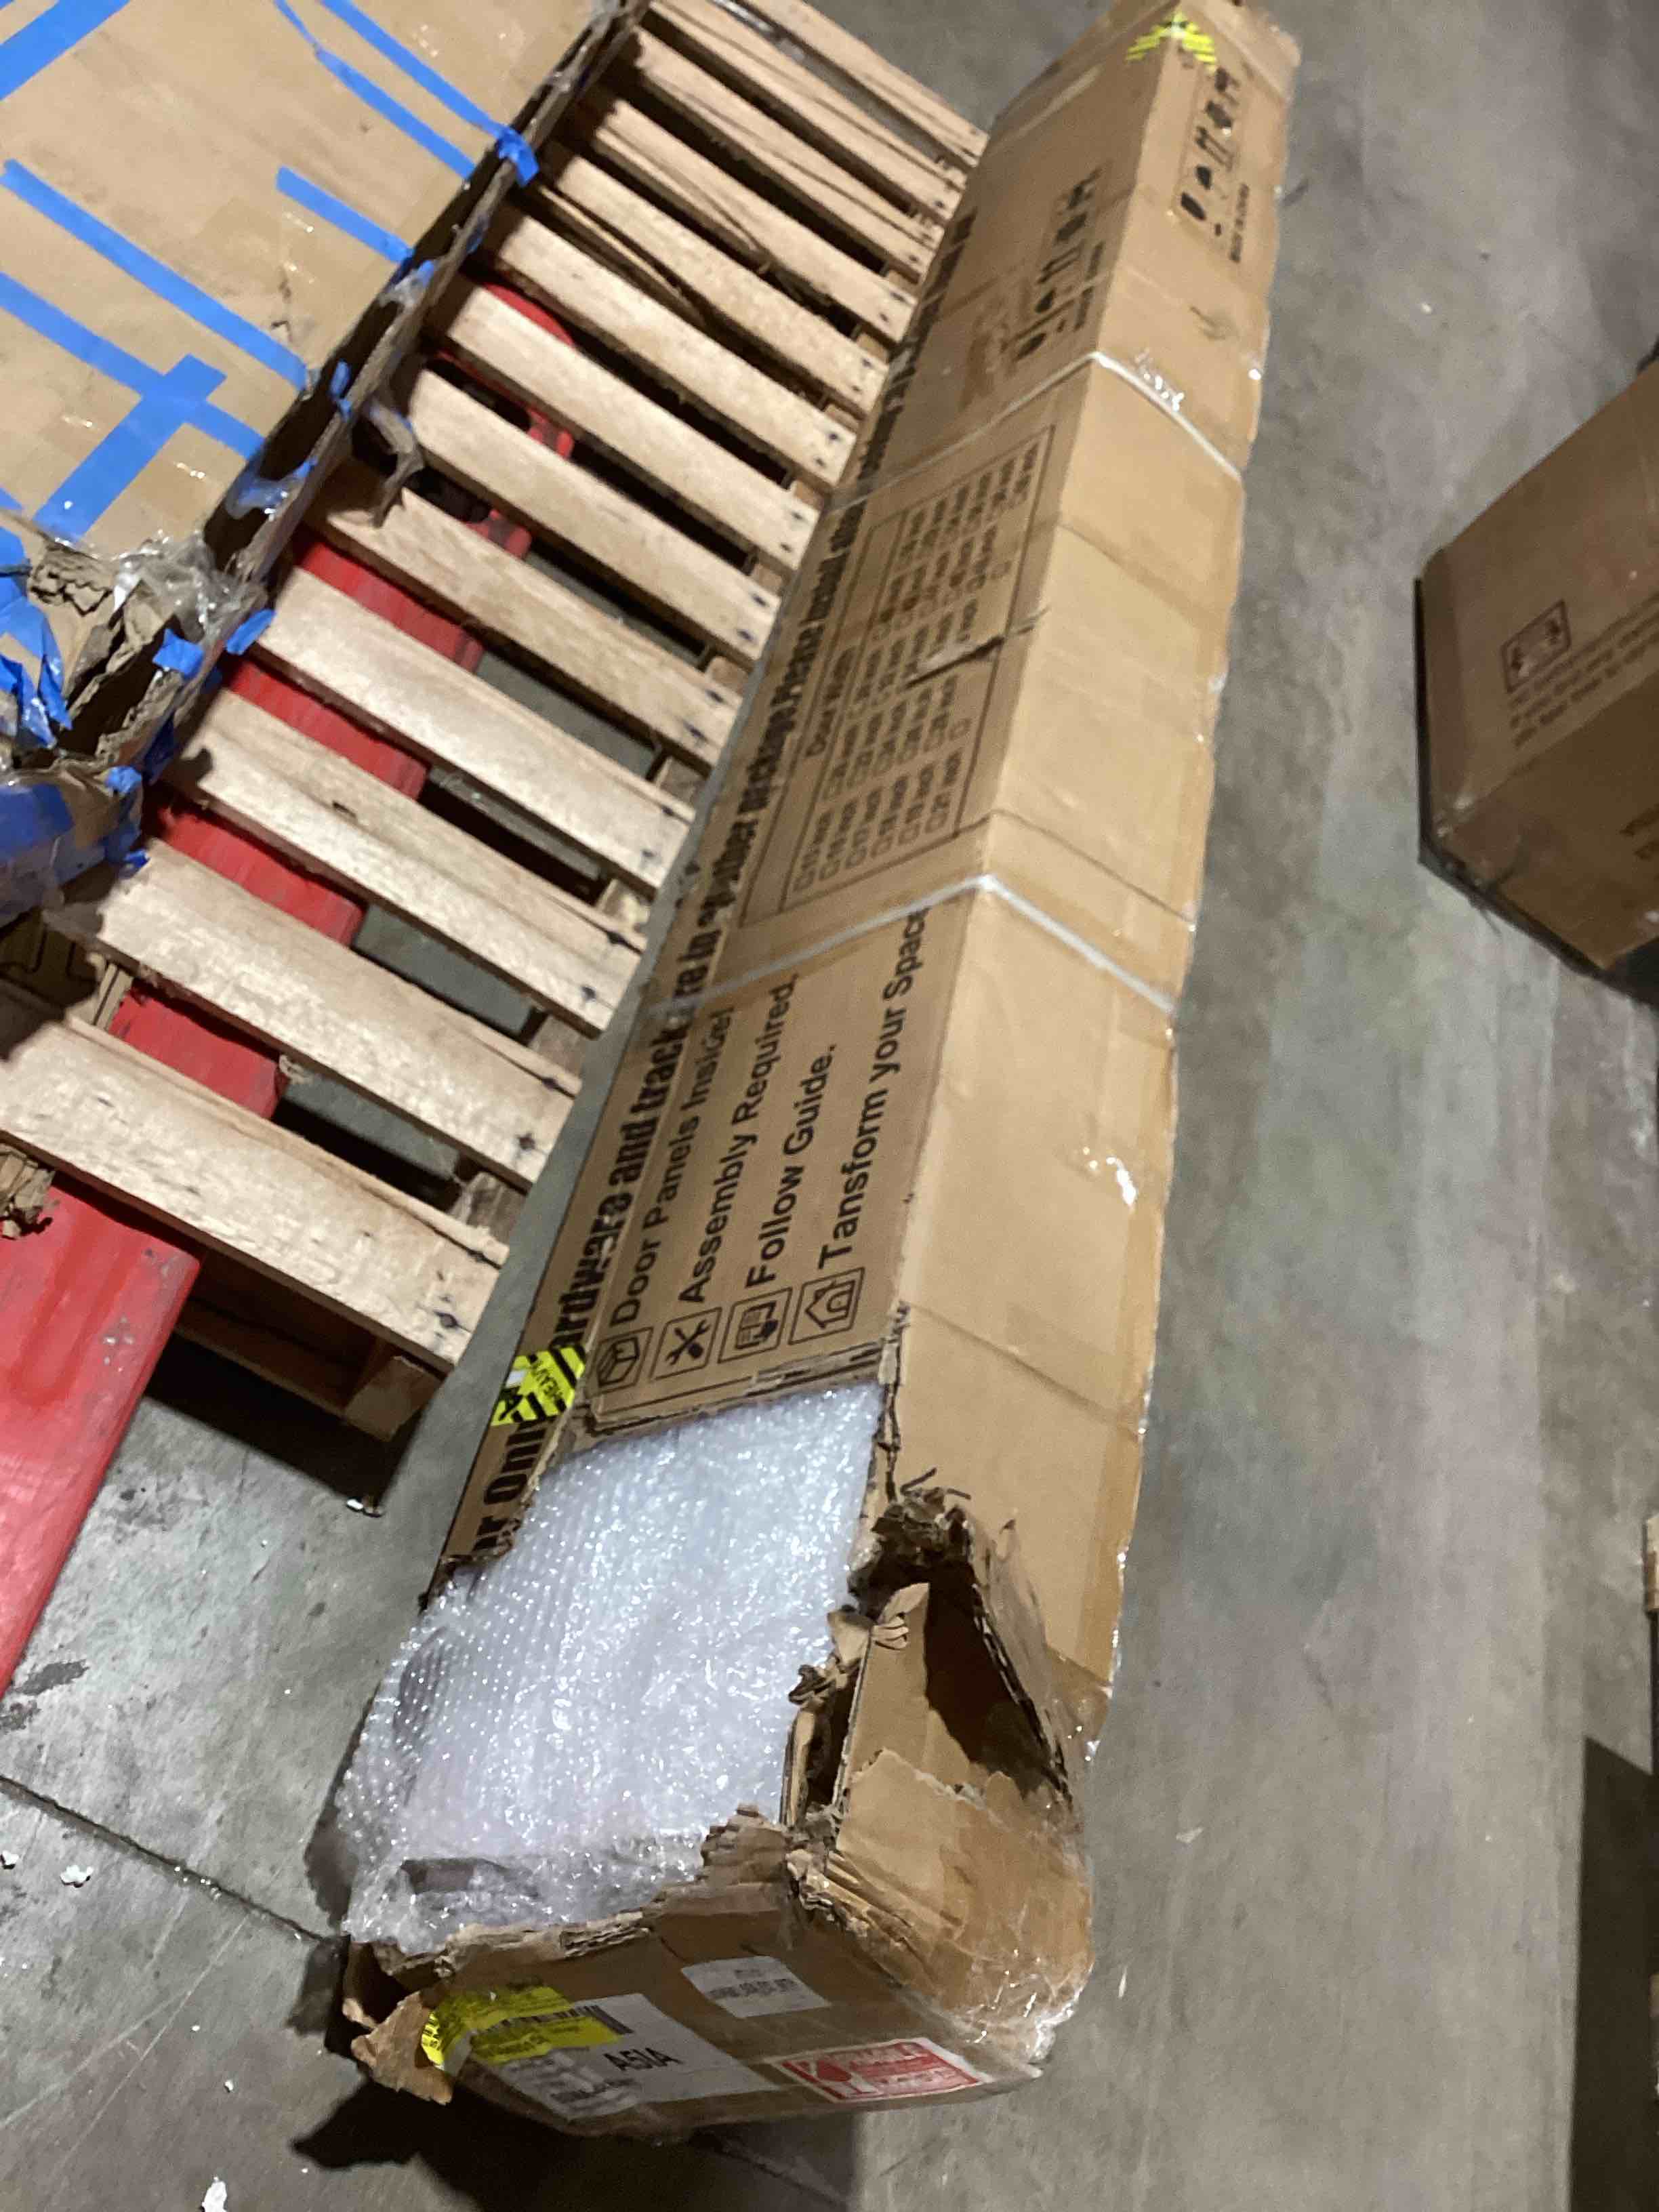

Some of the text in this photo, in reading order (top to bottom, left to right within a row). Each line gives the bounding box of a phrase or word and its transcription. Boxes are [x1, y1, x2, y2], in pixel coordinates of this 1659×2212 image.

[609, 1117, 659, 1187] and
[631, 1019, 690, 1114] track
[678, 972, 798, 1303] Assembly Required.
[817, 1088, 888, 1269] Tansform
[869, 1006, 906, 1083] your
[611, 1240, 661, 1327] Door
[643, 1115, 699, 1230] Panels
[745, 1044, 836, 1288] Follow Guide.
[549, 1192, 632, 1351] ardware
[484, 1418, 552, 1504] Onl
